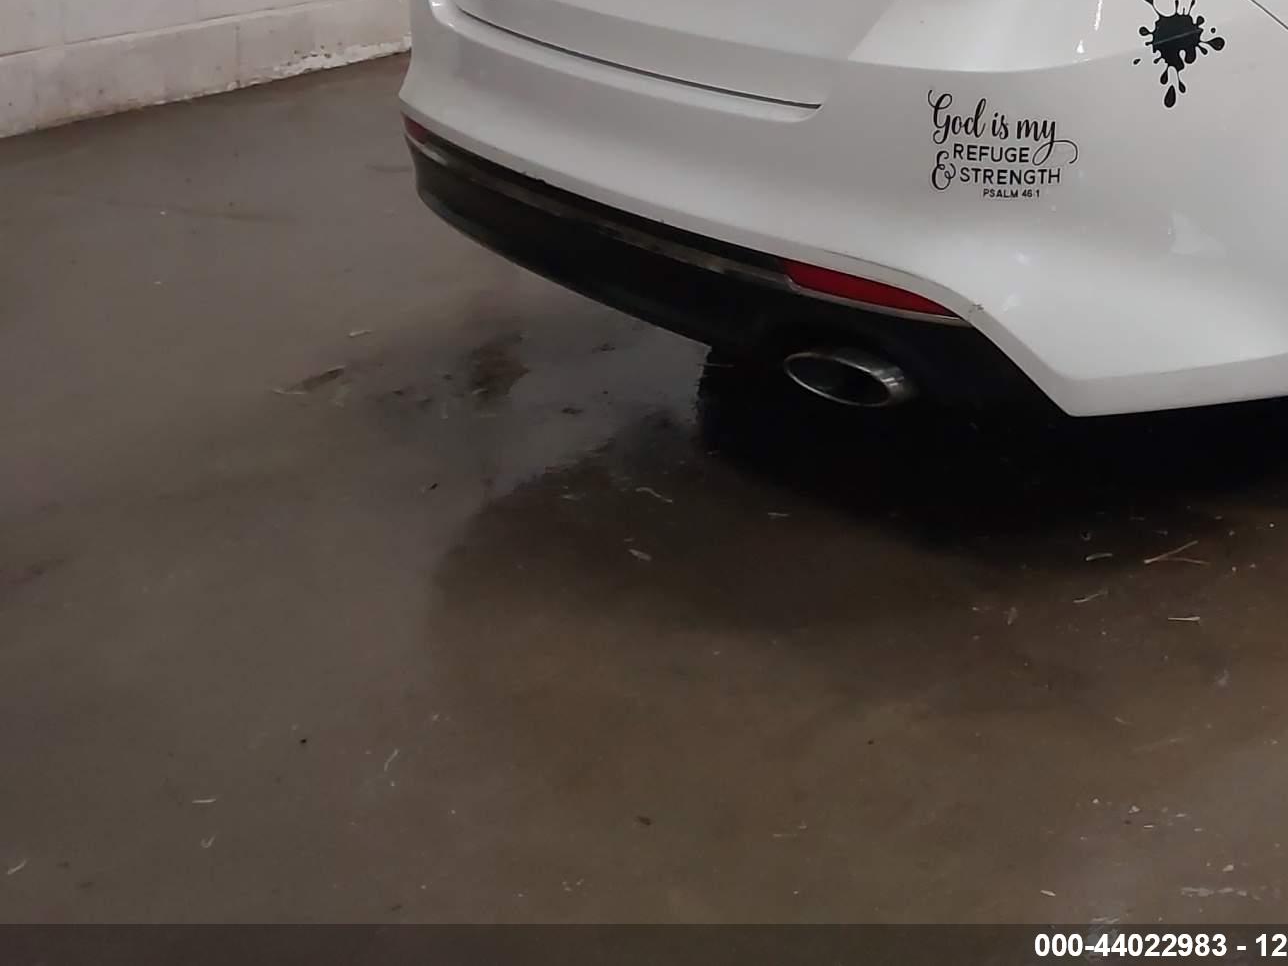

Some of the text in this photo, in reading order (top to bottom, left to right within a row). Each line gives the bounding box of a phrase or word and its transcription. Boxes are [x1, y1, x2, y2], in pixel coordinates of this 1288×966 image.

[928, 90, 1078, 166] God is my
[953, 143, 1030, 163] REFUGE
[960, 167, 1061, 185] STRENGTH
[983, 188, 1040, 198] PSALM 461
